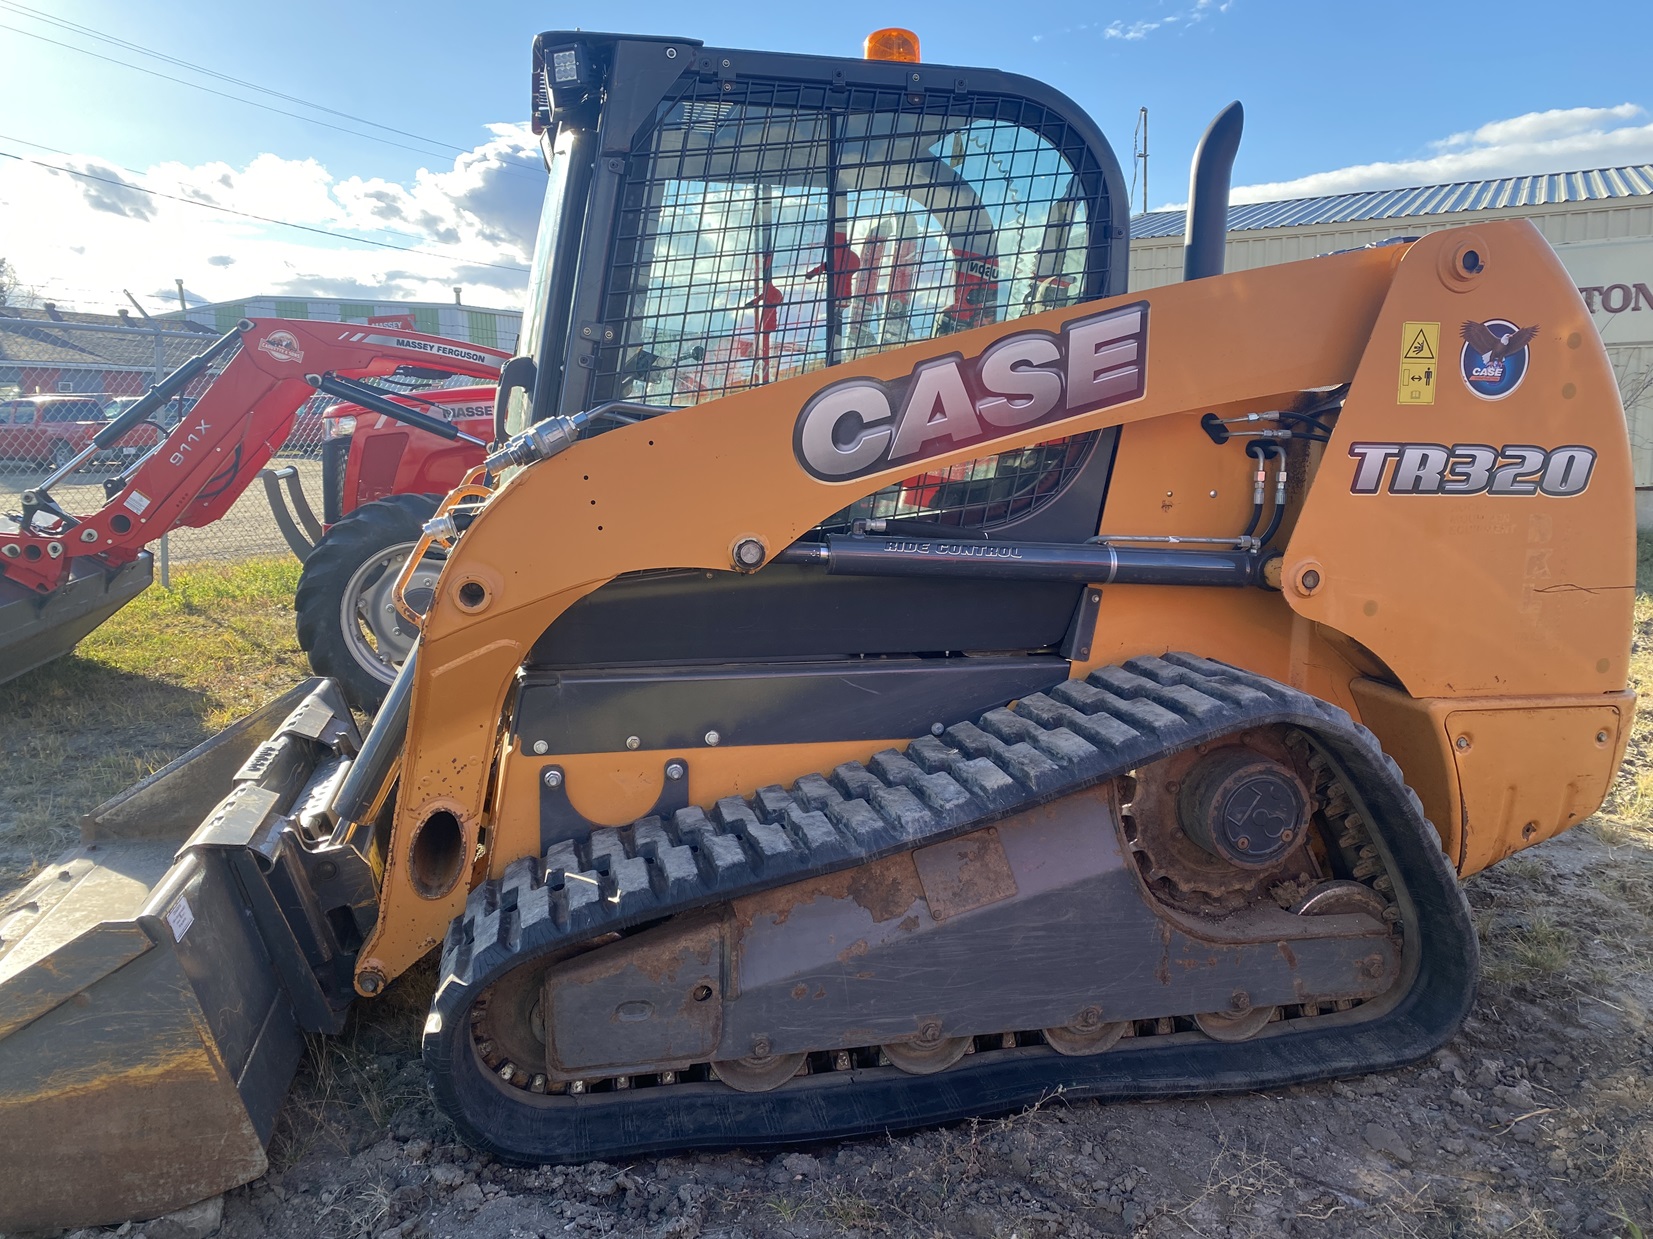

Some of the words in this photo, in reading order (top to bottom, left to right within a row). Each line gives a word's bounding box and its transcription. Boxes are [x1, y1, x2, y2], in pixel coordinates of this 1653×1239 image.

[396, 338, 435, 352] MASSEY
[436, 346, 486, 363] FERGUSON
[1472, 367, 1504, 377] CASE
[798, 306, 1145, 478] CASE
[443, 405, 495, 419] MASSE
[169, 419, 212, 467] 911X
[1349, 443, 1597, 496] TR320
[884, 541, 930, 554] RIDE
[936, 543, 1023, 559] CONTROL
